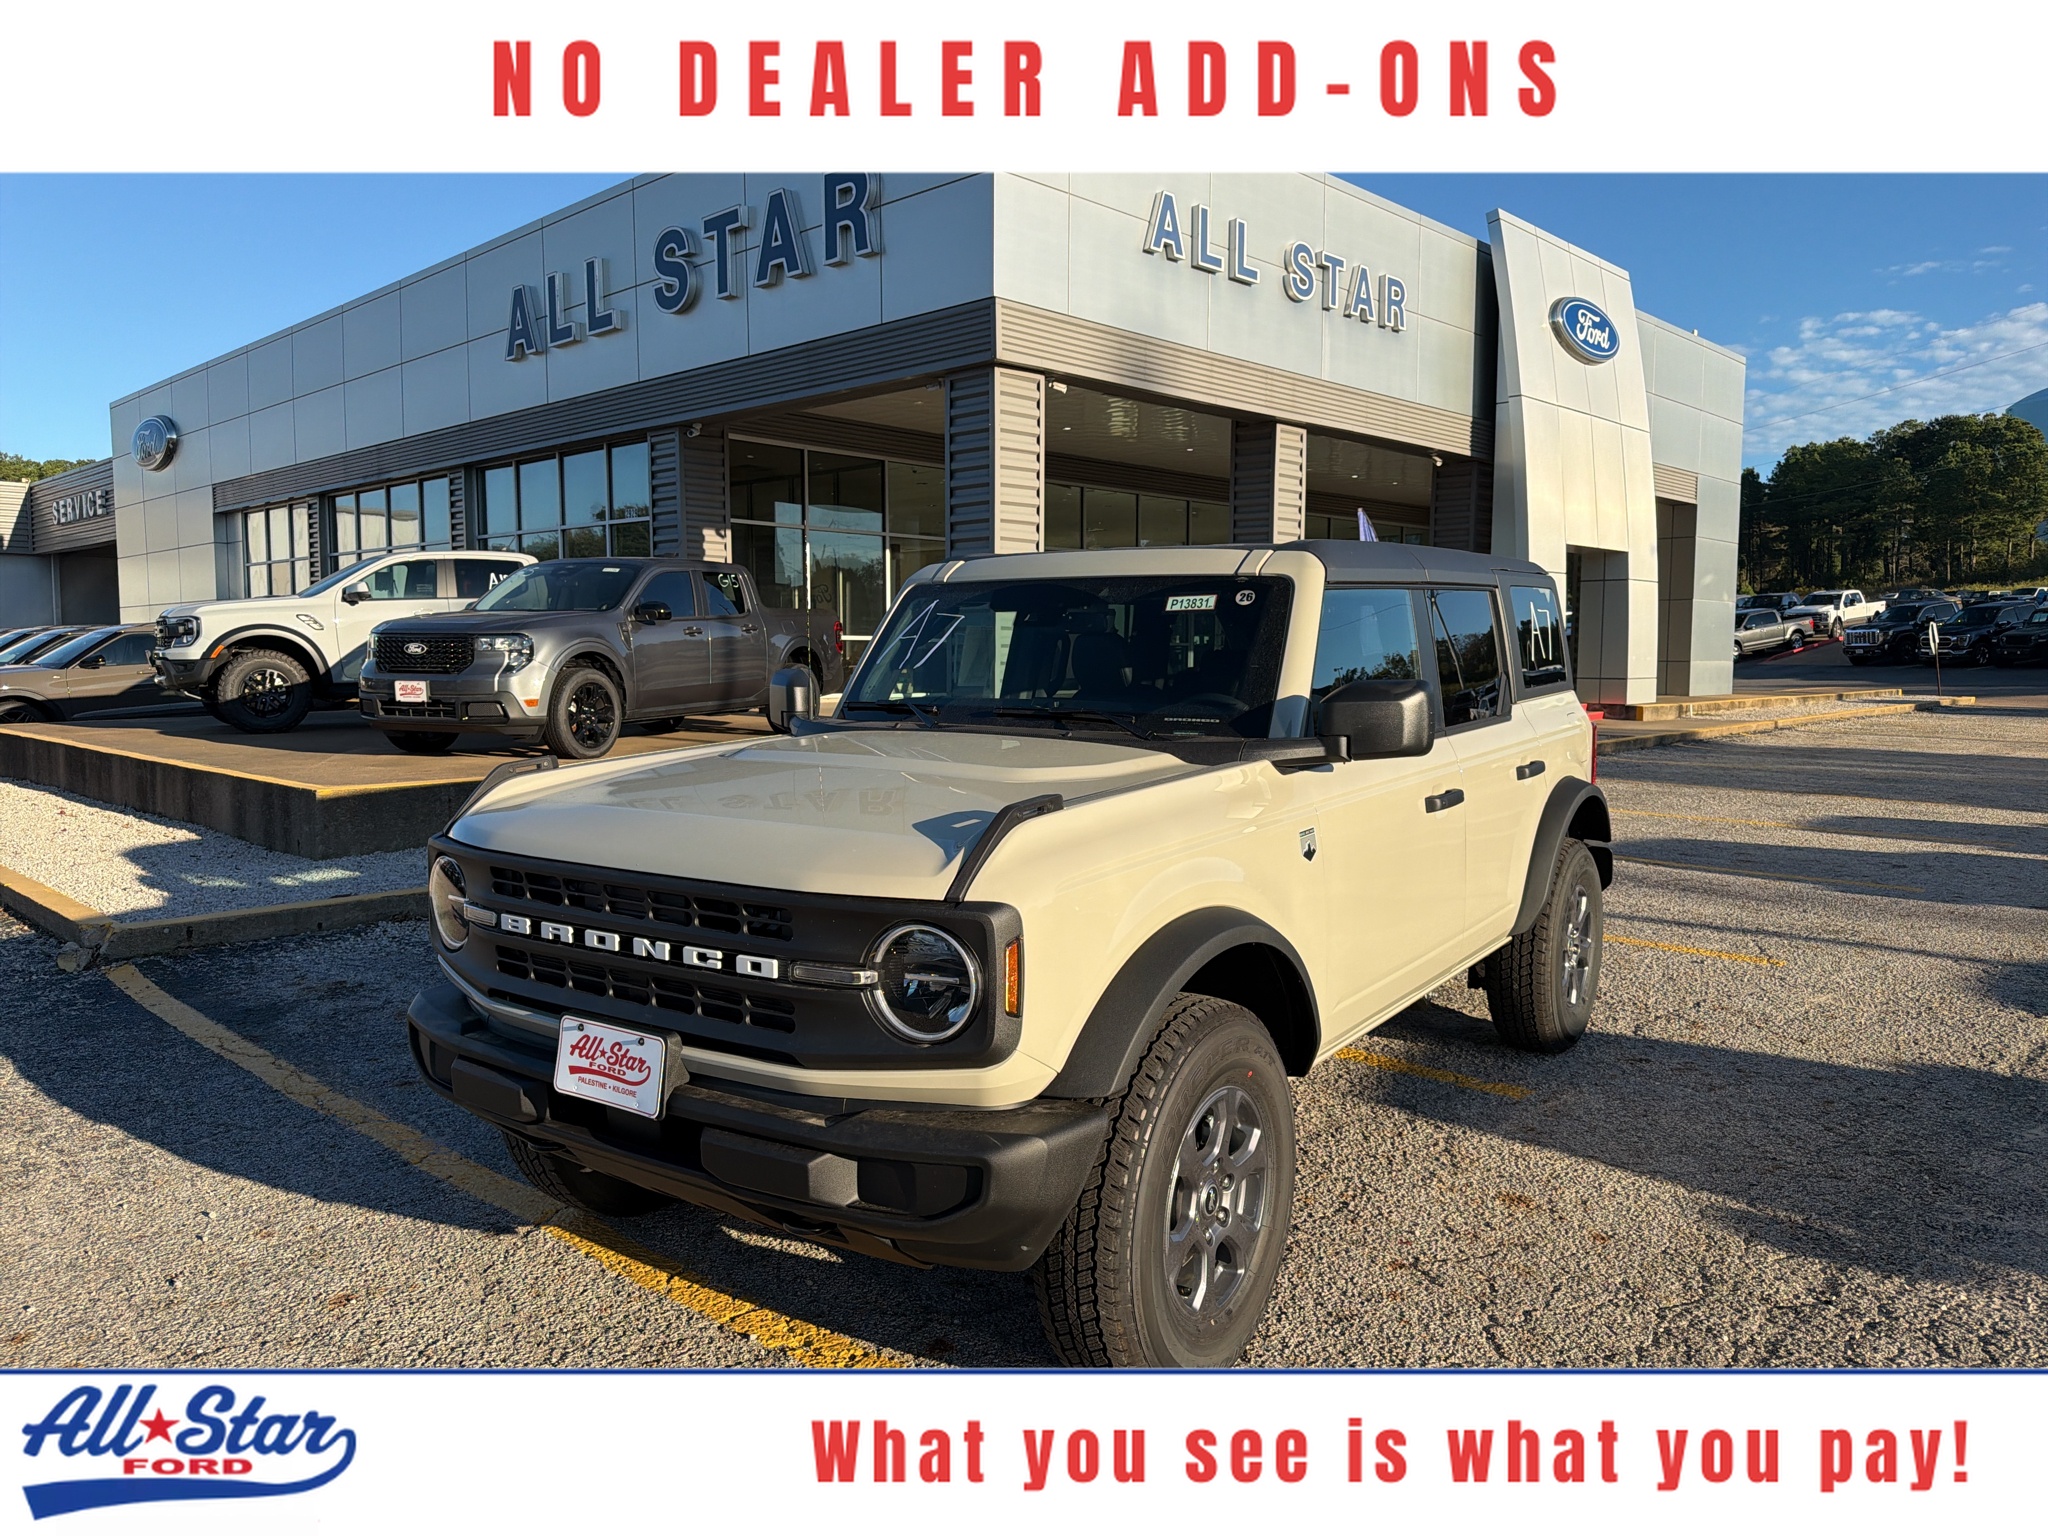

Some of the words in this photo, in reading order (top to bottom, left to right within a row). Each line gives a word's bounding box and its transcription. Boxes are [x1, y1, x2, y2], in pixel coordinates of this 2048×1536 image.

[505, 257, 622, 361] ALL
[652, 172, 880, 314] STAR
[1143, 190, 1260, 285] ALL
[1283, 240, 1407, 332] STAR
[1576, 308, 1610, 350] Ford
[135, 429, 158, 461] Ford
[52, 490, 106, 525] SERVICE
[1170, 597, 1210, 610] P13831
[1238, 592, 1254, 603] 26
[875, 599, 966, 669] A7
[1530, 601, 1552, 662] A7
[501, 913, 778, 979] BRONCO
[569, 1034, 604, 1060] All
[606, 1041, 648, 1073] Star
[588, 1061, 627, 1077] FORD
[577, 1076, 608, 1090] PALESTINE
[612, 1085, 637, 1098] KILGORE
